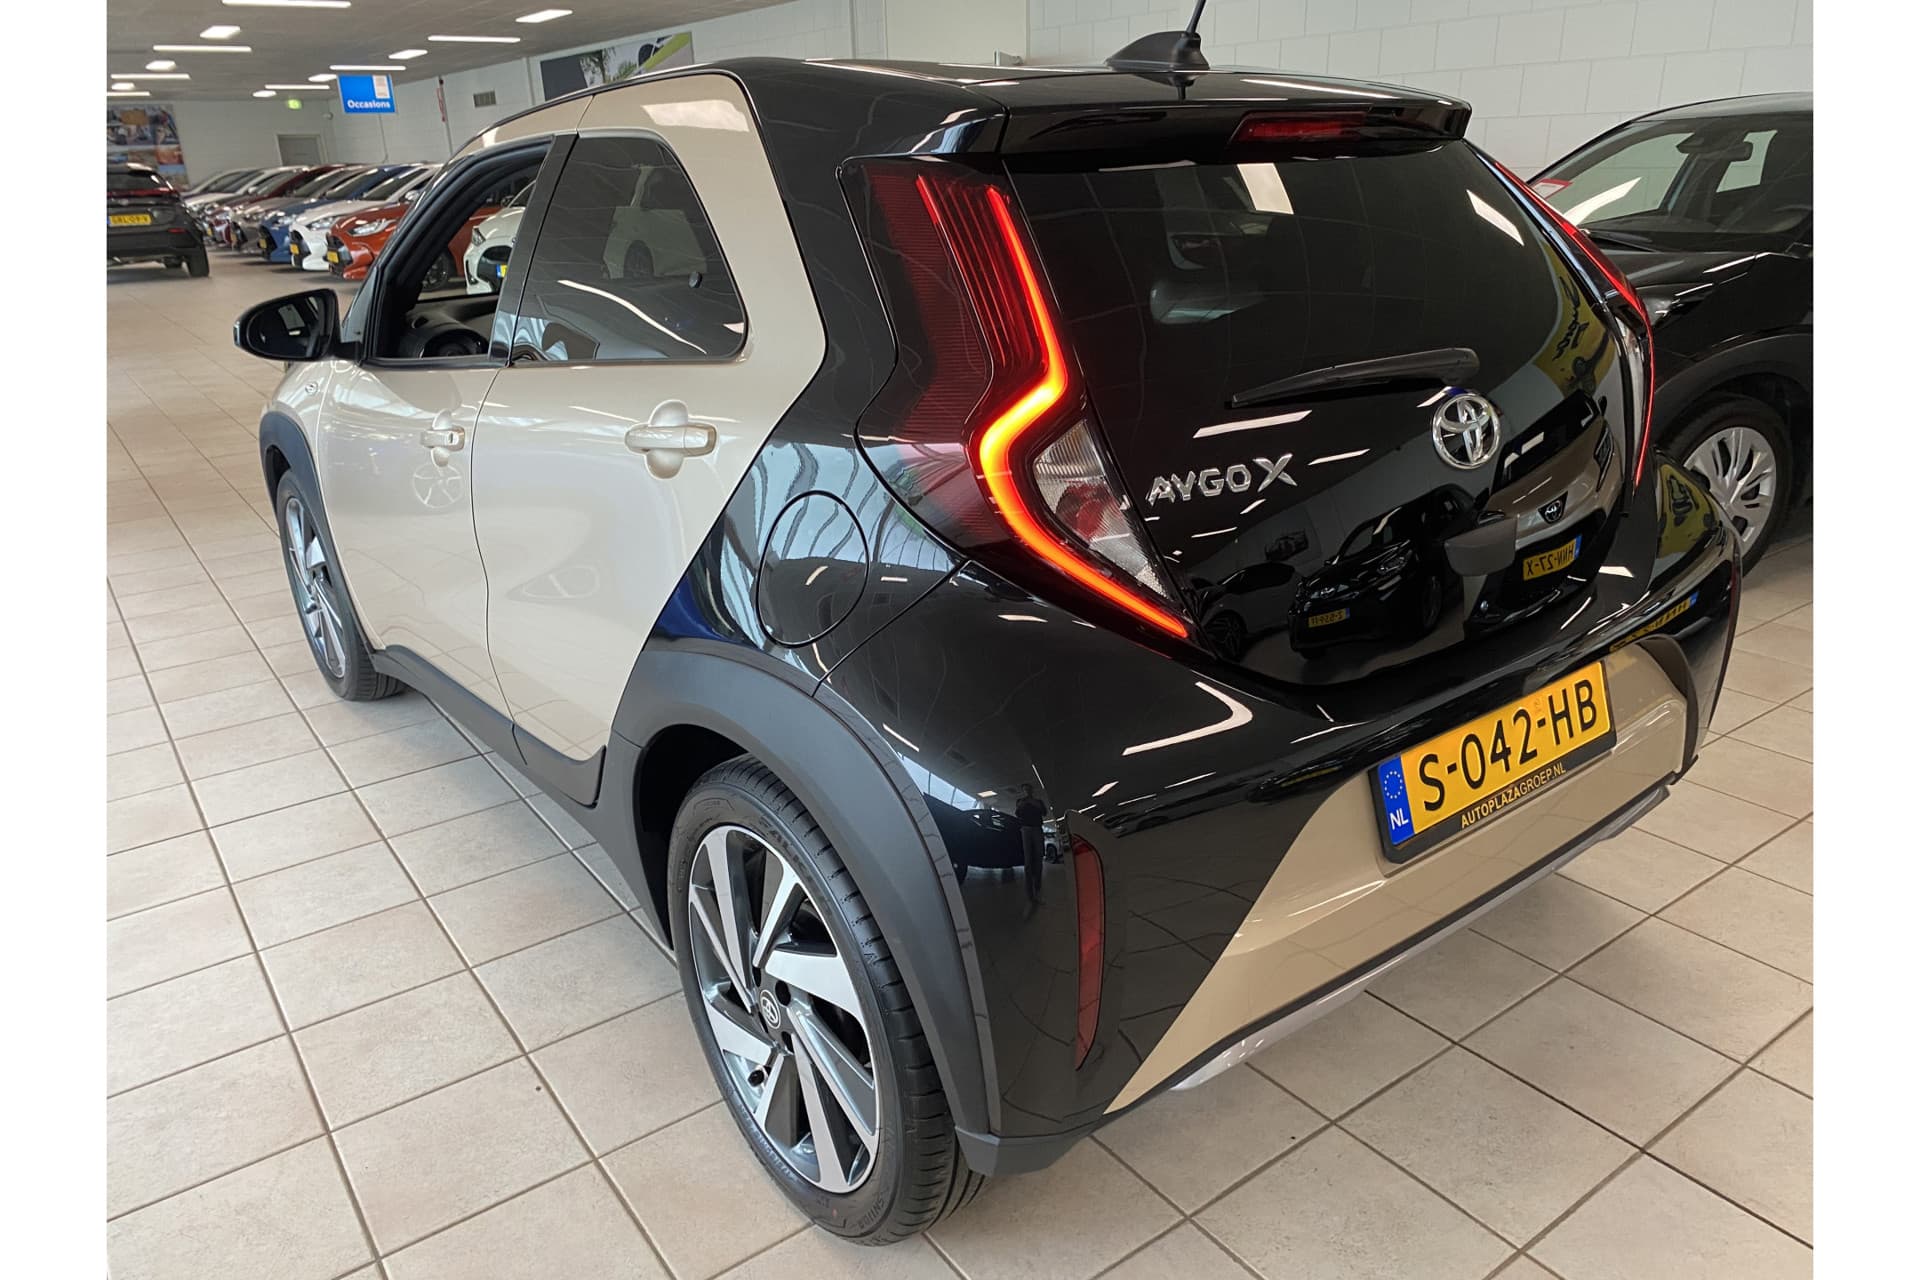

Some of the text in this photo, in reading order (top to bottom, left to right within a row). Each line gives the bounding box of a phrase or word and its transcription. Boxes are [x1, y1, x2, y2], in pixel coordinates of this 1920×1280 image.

[347, 99, 391, 109] Occasions
[1145, 452, 1298, 506] AYGO X
[1389, 679, 1597, 831] NL S-042-HB
[1460, 761, 1567, 829] AUTOPLAZAGROEP.NL
